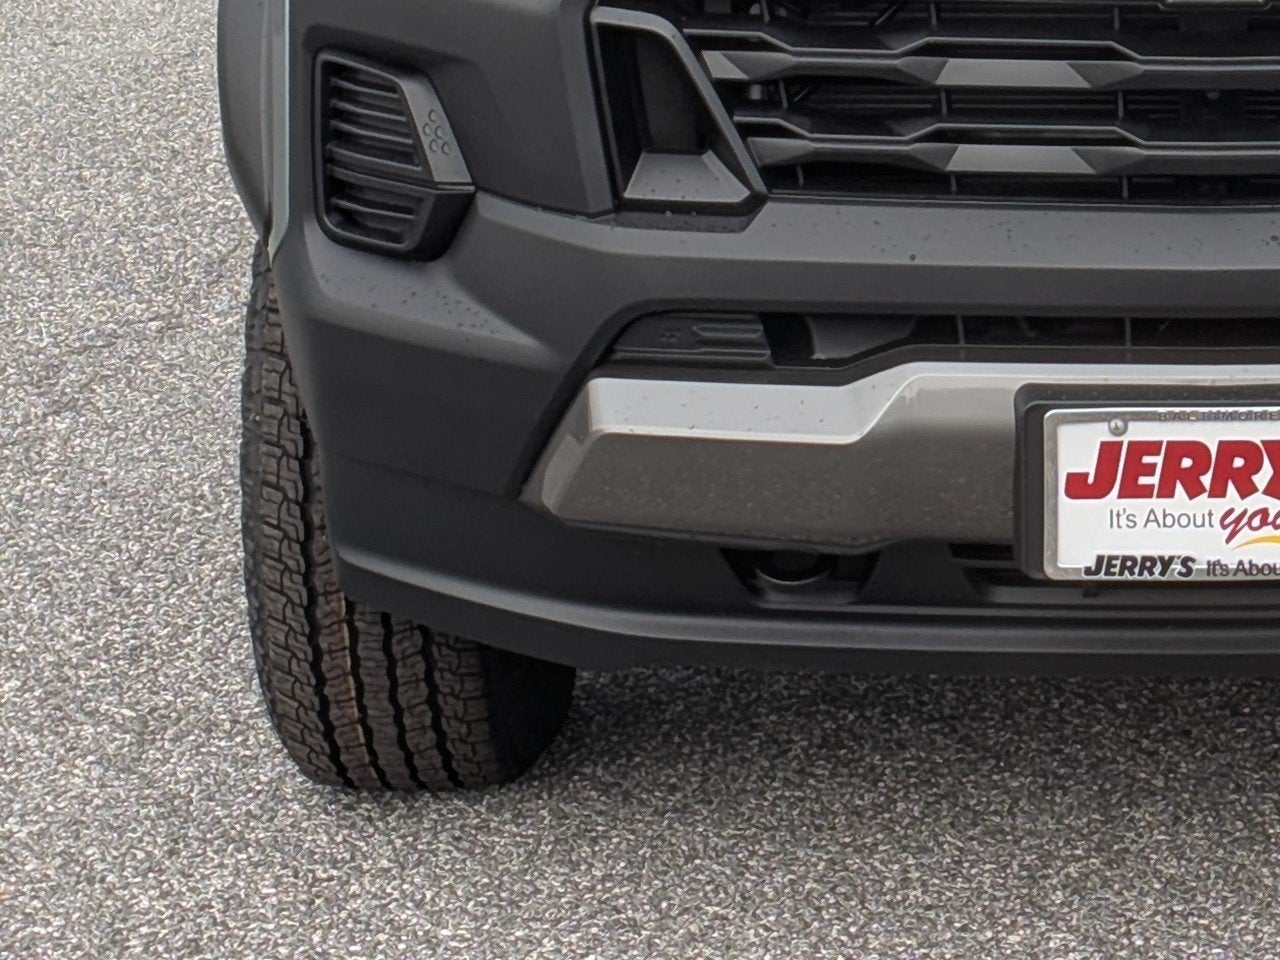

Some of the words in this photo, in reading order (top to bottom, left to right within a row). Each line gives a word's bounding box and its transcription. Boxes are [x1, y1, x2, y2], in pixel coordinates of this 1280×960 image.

[1158, 410, 1279, 420] BALTIMORE
[1109, 509, 1137, 528] It's
[1144, 508, 1214, 528] About
[1084, 555, 1196, 577] JERRY'S
[1207, 559, 1231, 575] It's
